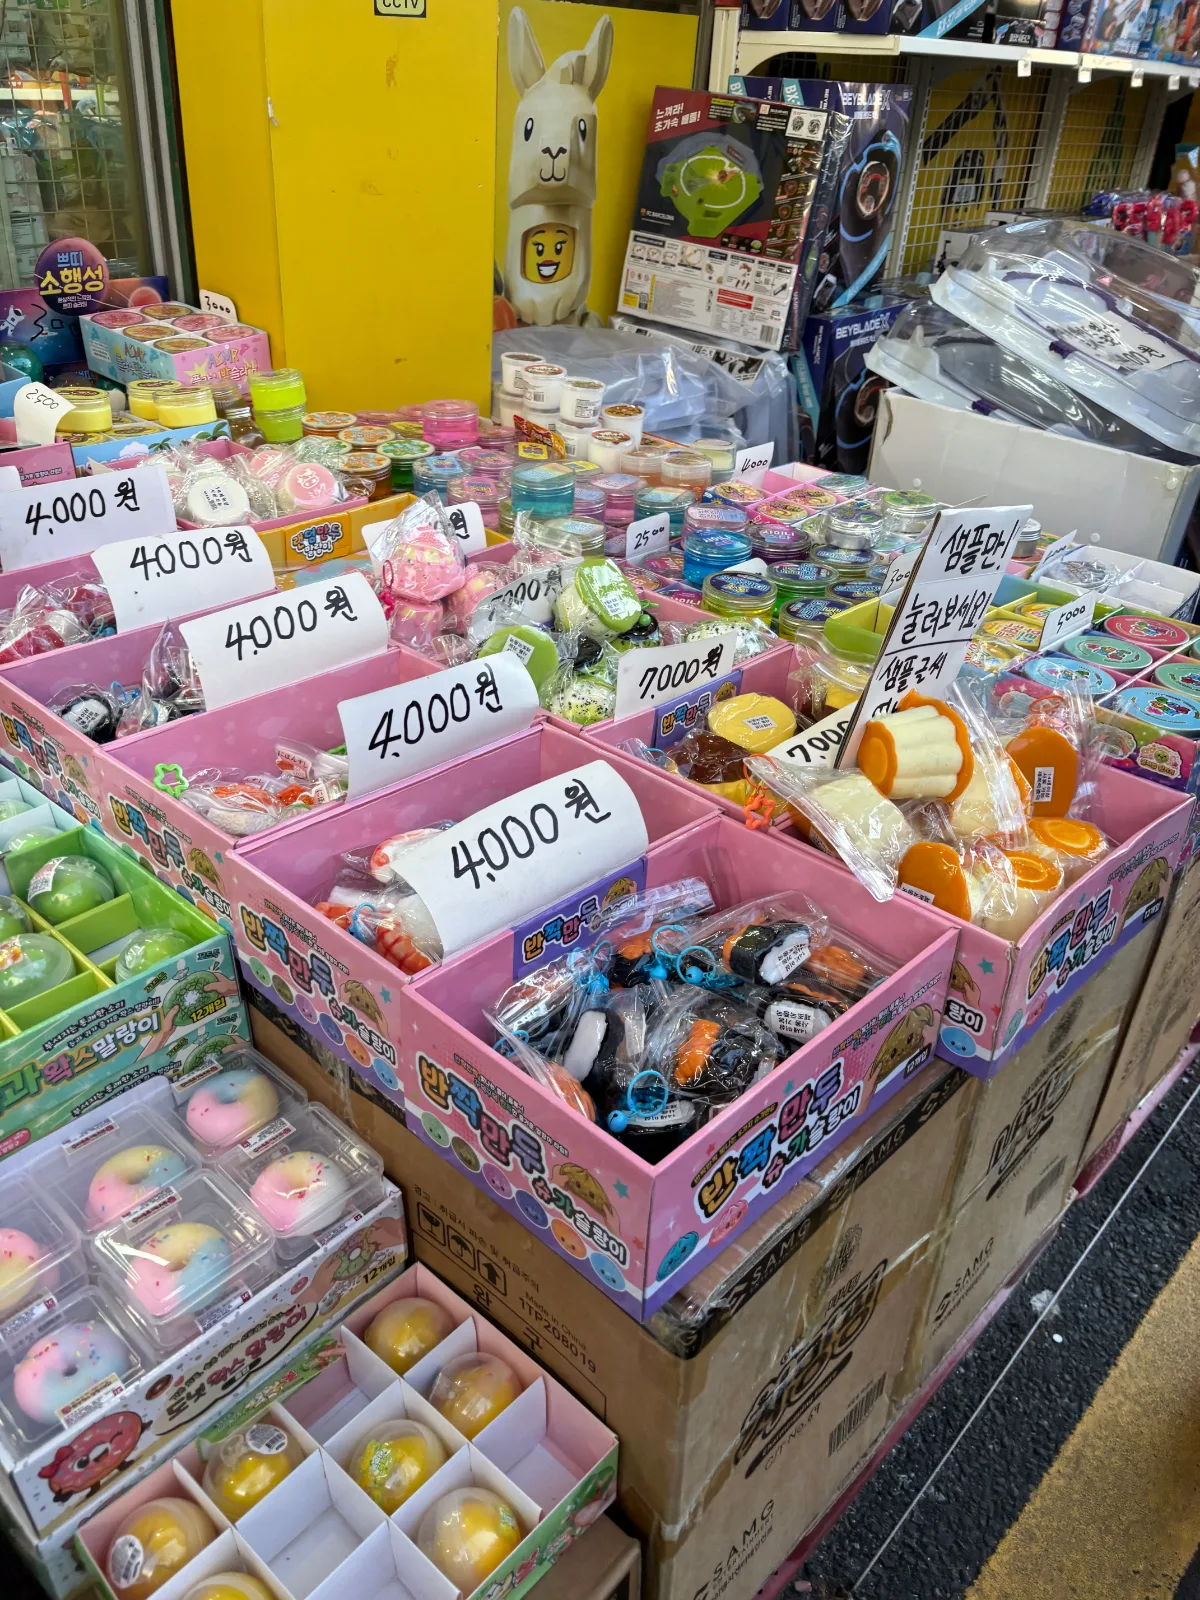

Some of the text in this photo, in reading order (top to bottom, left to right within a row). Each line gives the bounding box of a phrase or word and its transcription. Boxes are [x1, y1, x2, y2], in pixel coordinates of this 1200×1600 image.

[655, 103, 684, 119] 느껴라!
[842, 93, 882, 106] BEYBLADE
[654, 117, 679, 132] 초가속
[57, 251, 83, 267] 쁘띠
[39, 265, 104, 296] 소행성
[204, 295, 231, 314] 3000
[836, 318, 880, 339] BEYBLADE
[208, 349, 240, 369] ASMR
[741, 457, 769, 474] 4000
[940, 518, 1019, 575] 샘플만!
[901, 590, 993, 645] 눌러보세요!
[1056, 604, 1087, 634] 5000
[109, 795, 186, 869] 반짝만두
[523, 897, 599, 961] 반짝만두
[1028, 888, 1111, 1000] 반짝만두
[240, 903, 338, 998] 반짝만두
[108, 999, 125, 1013] 소리
[191, 996, 226, 1023] 12개입
[131, 1065, 149, 1079] 소리
[418, 1054, 546, 1176] 반짝만두
[698, 1062, 842, 1219] 반짝만두
[761, 1085, 862, 1190] 슈가슬랑이
[531, 1174, 628, 1267] 슈가슬랑이
[363, 1256, 396, 1285] 12개입
[953, 1237, 994, 1288] SAMG
[519, 1297, 597, 1374] 1TP208019
[523, 1326, 543, 1351] 구
[525, 1291, 587, 1351] Made in China
[166, 1382, 206, 1421] 도넛
[206, 1358, 246, 1386] 왁스
[713, 1499, 774, 1582] SAMG
